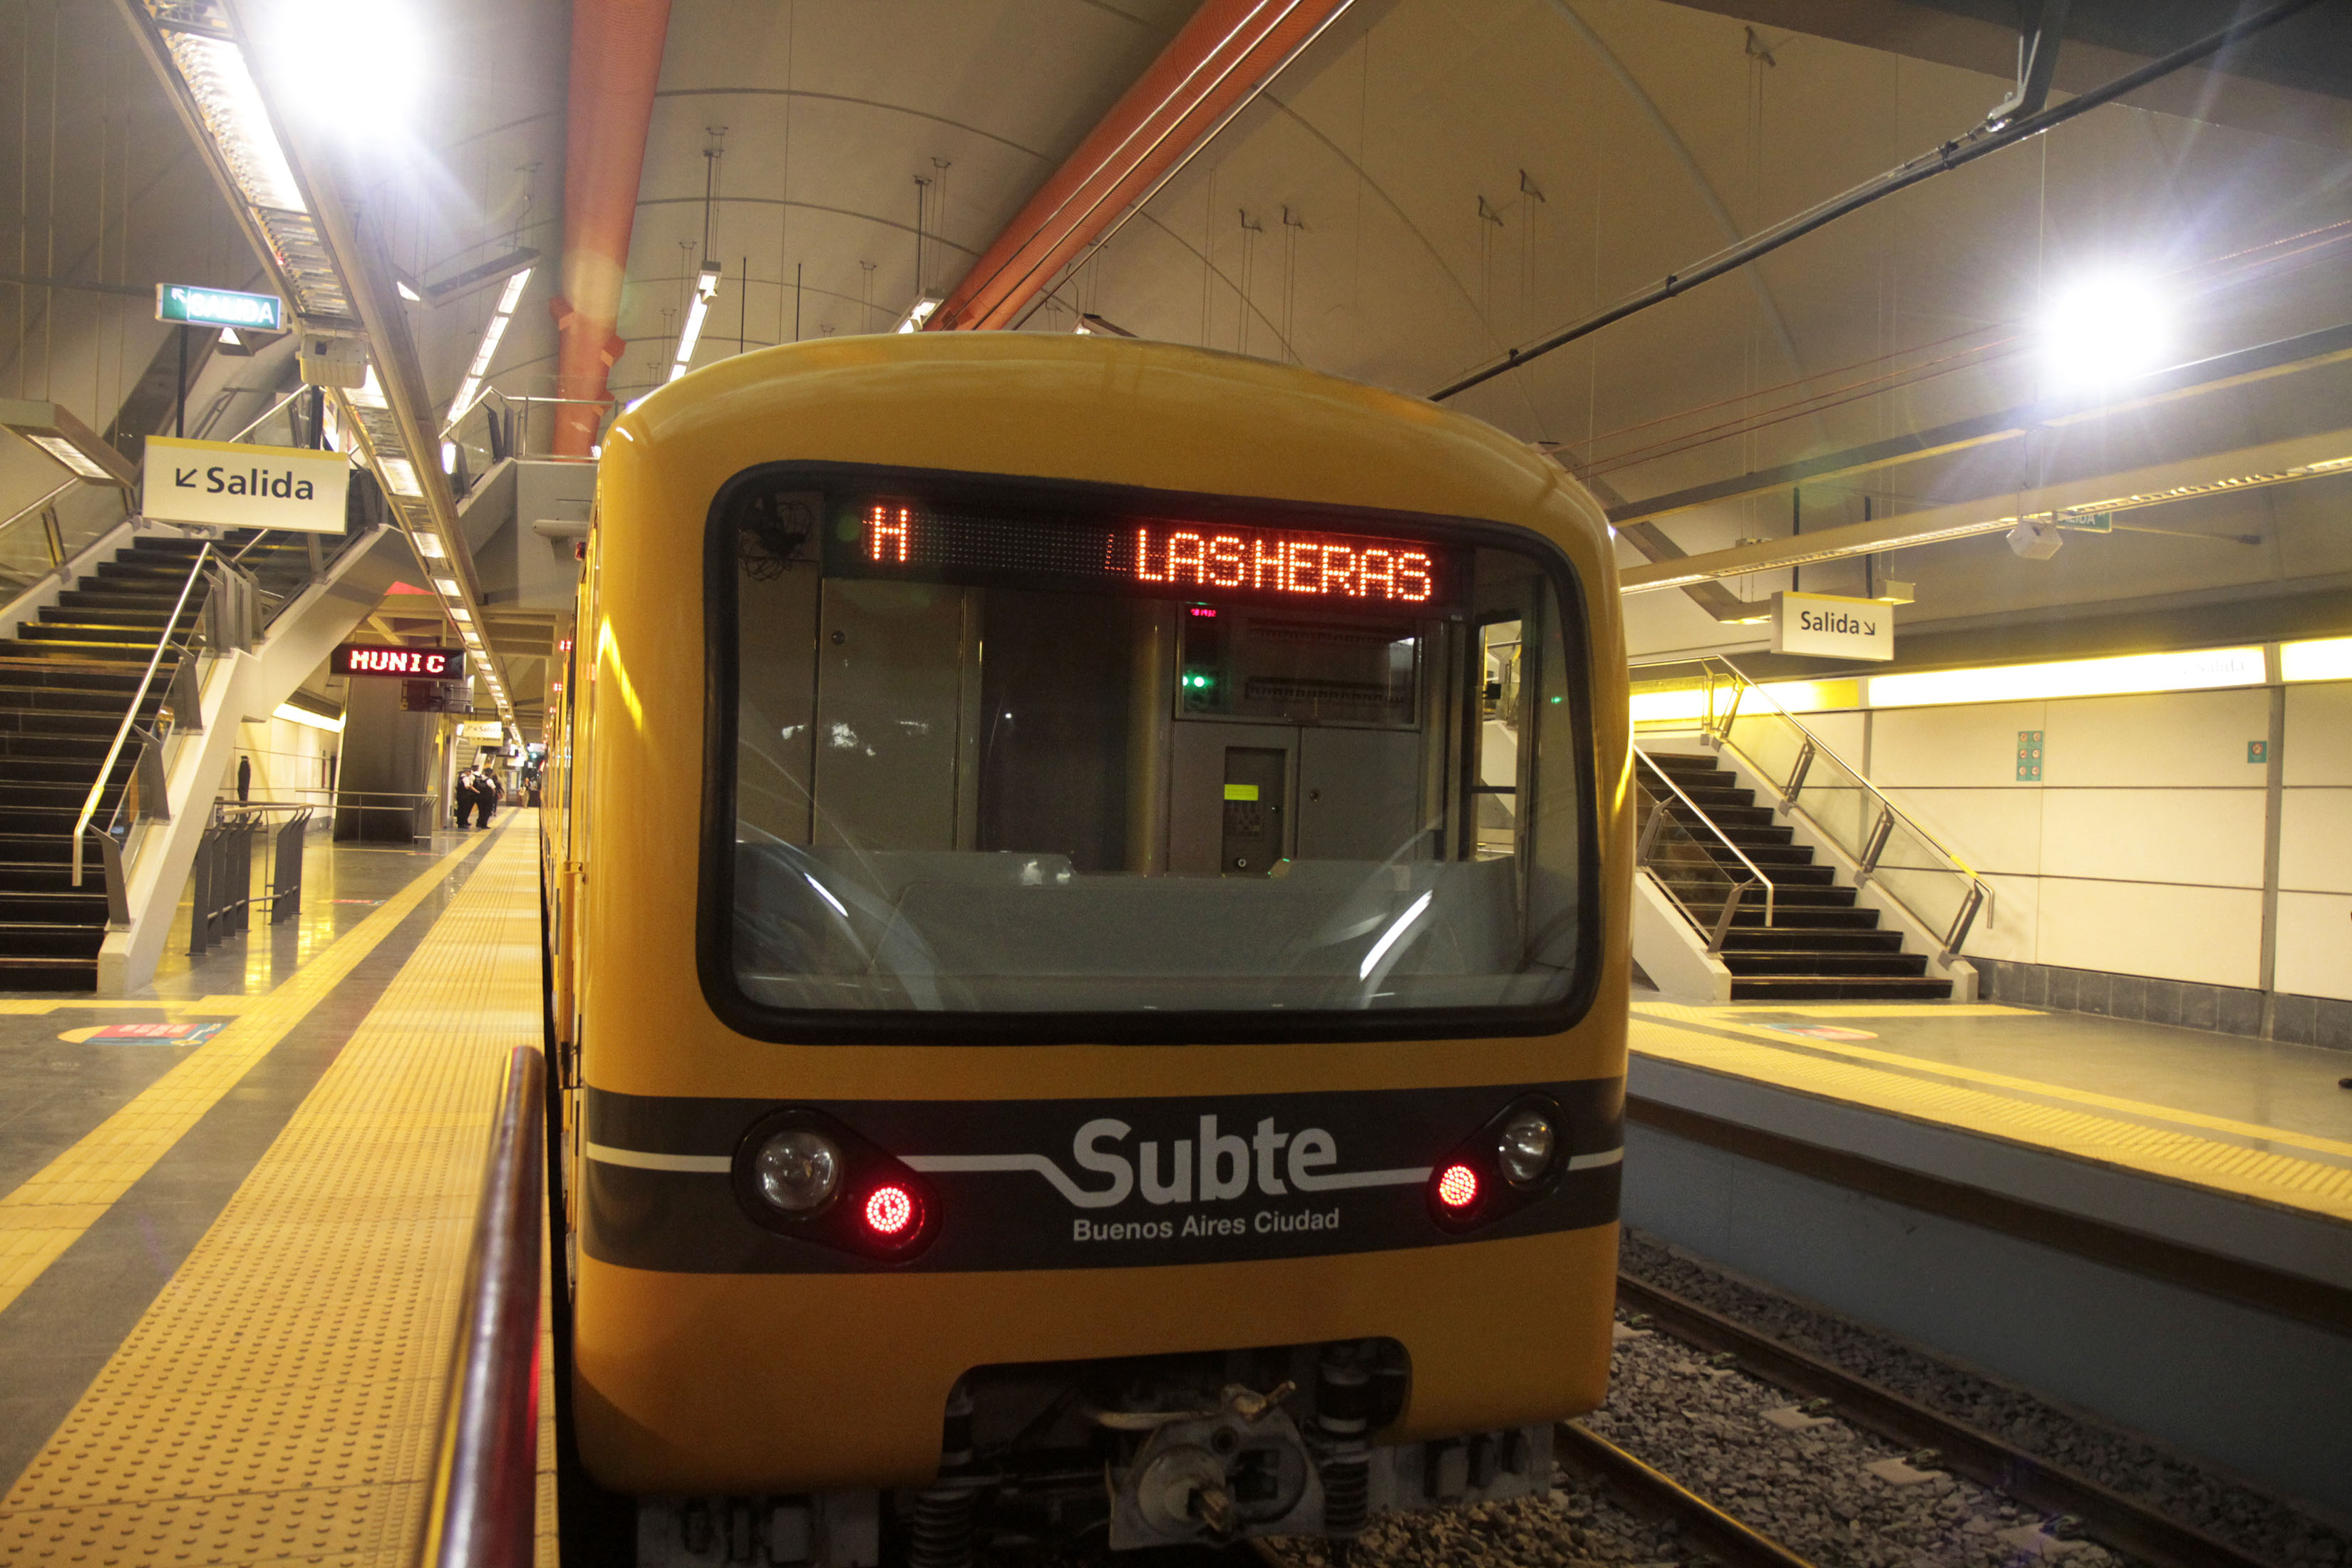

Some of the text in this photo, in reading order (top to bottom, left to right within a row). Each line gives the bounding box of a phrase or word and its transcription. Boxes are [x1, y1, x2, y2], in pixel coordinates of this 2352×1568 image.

[190, 293, 274, 324] SALIDA
[207, 467, 314, 500] Salida
[873, 507, 907, 562] H
[1801, 611, 1860, 634] Salida
[350, 651, 445, 673] MUNIC
[1073, 1115, 1337, 1207] Subte
[1073, 1207, 1339, 1241] Buenos Aires Ciudad
